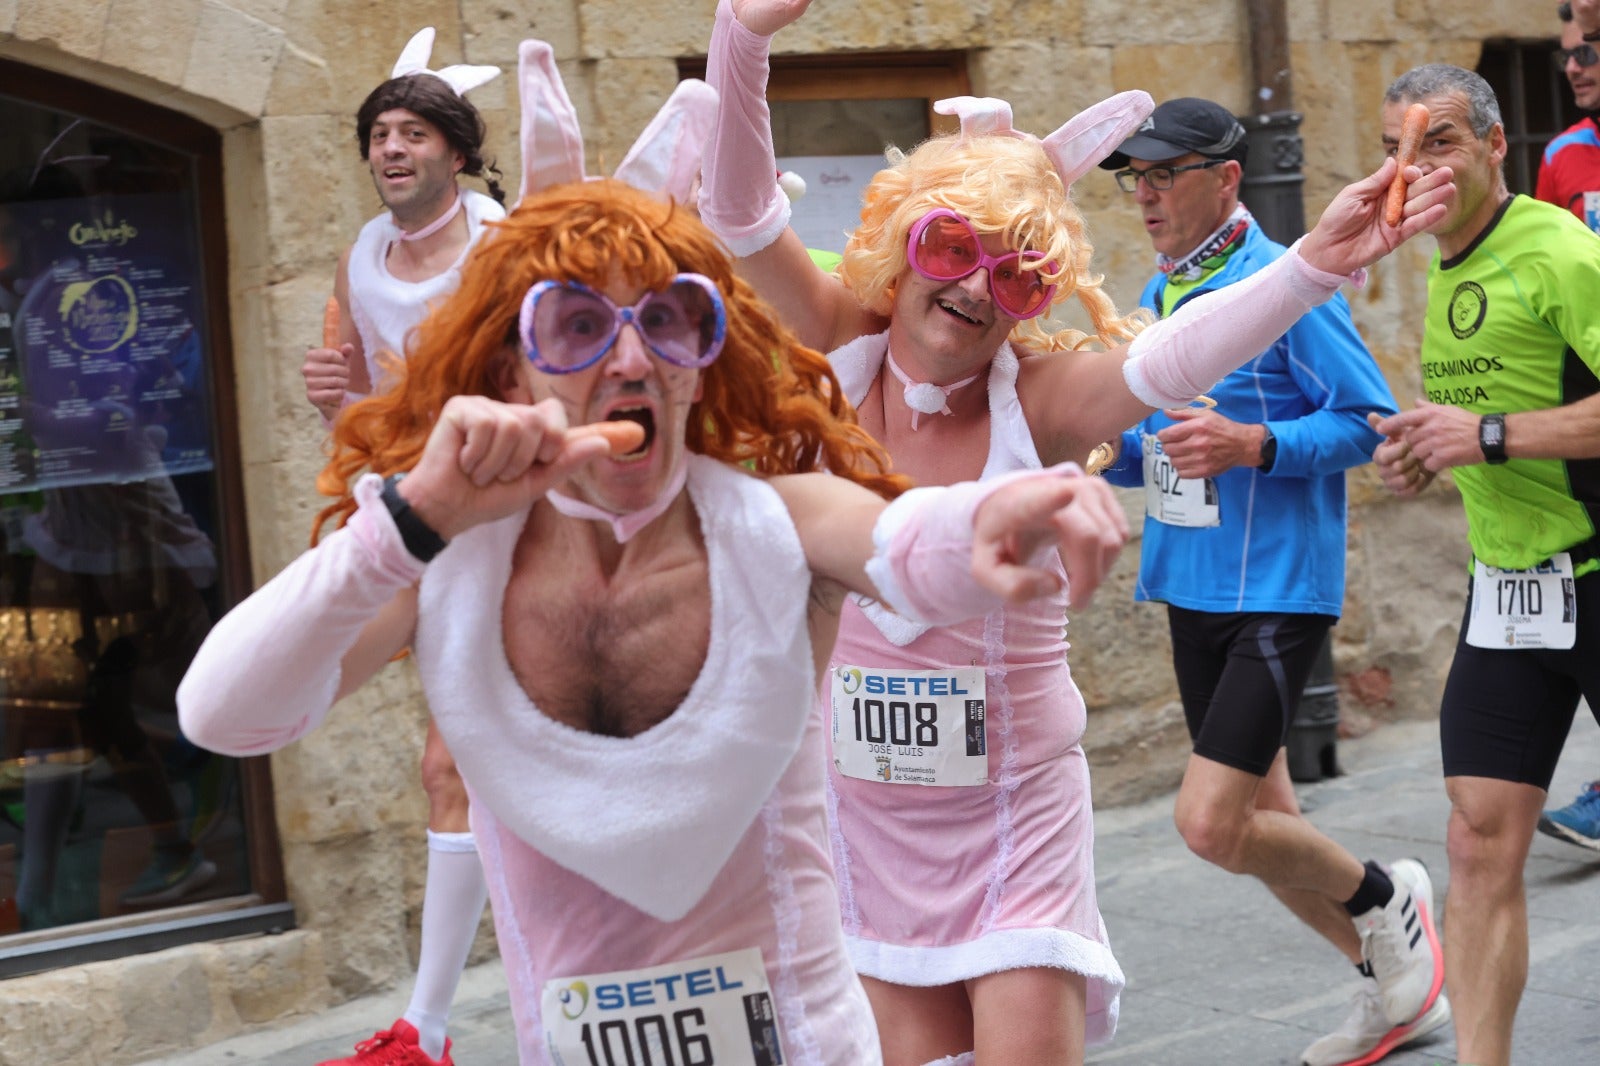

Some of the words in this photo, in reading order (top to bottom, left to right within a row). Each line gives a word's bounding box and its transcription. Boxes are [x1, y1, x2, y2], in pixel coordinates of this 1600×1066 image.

[1497, 579, 1542, 615] 1710
[865, 675, 968, 696] SETEL
[852, 697, 938, 747] 1008
[868, 744, 892, 755] JOSÉ
[898, 747, 924, 757] LUIS
[595, 966, 744, 1010] SETEL
[581, 1007, 714, 1066] 1006
